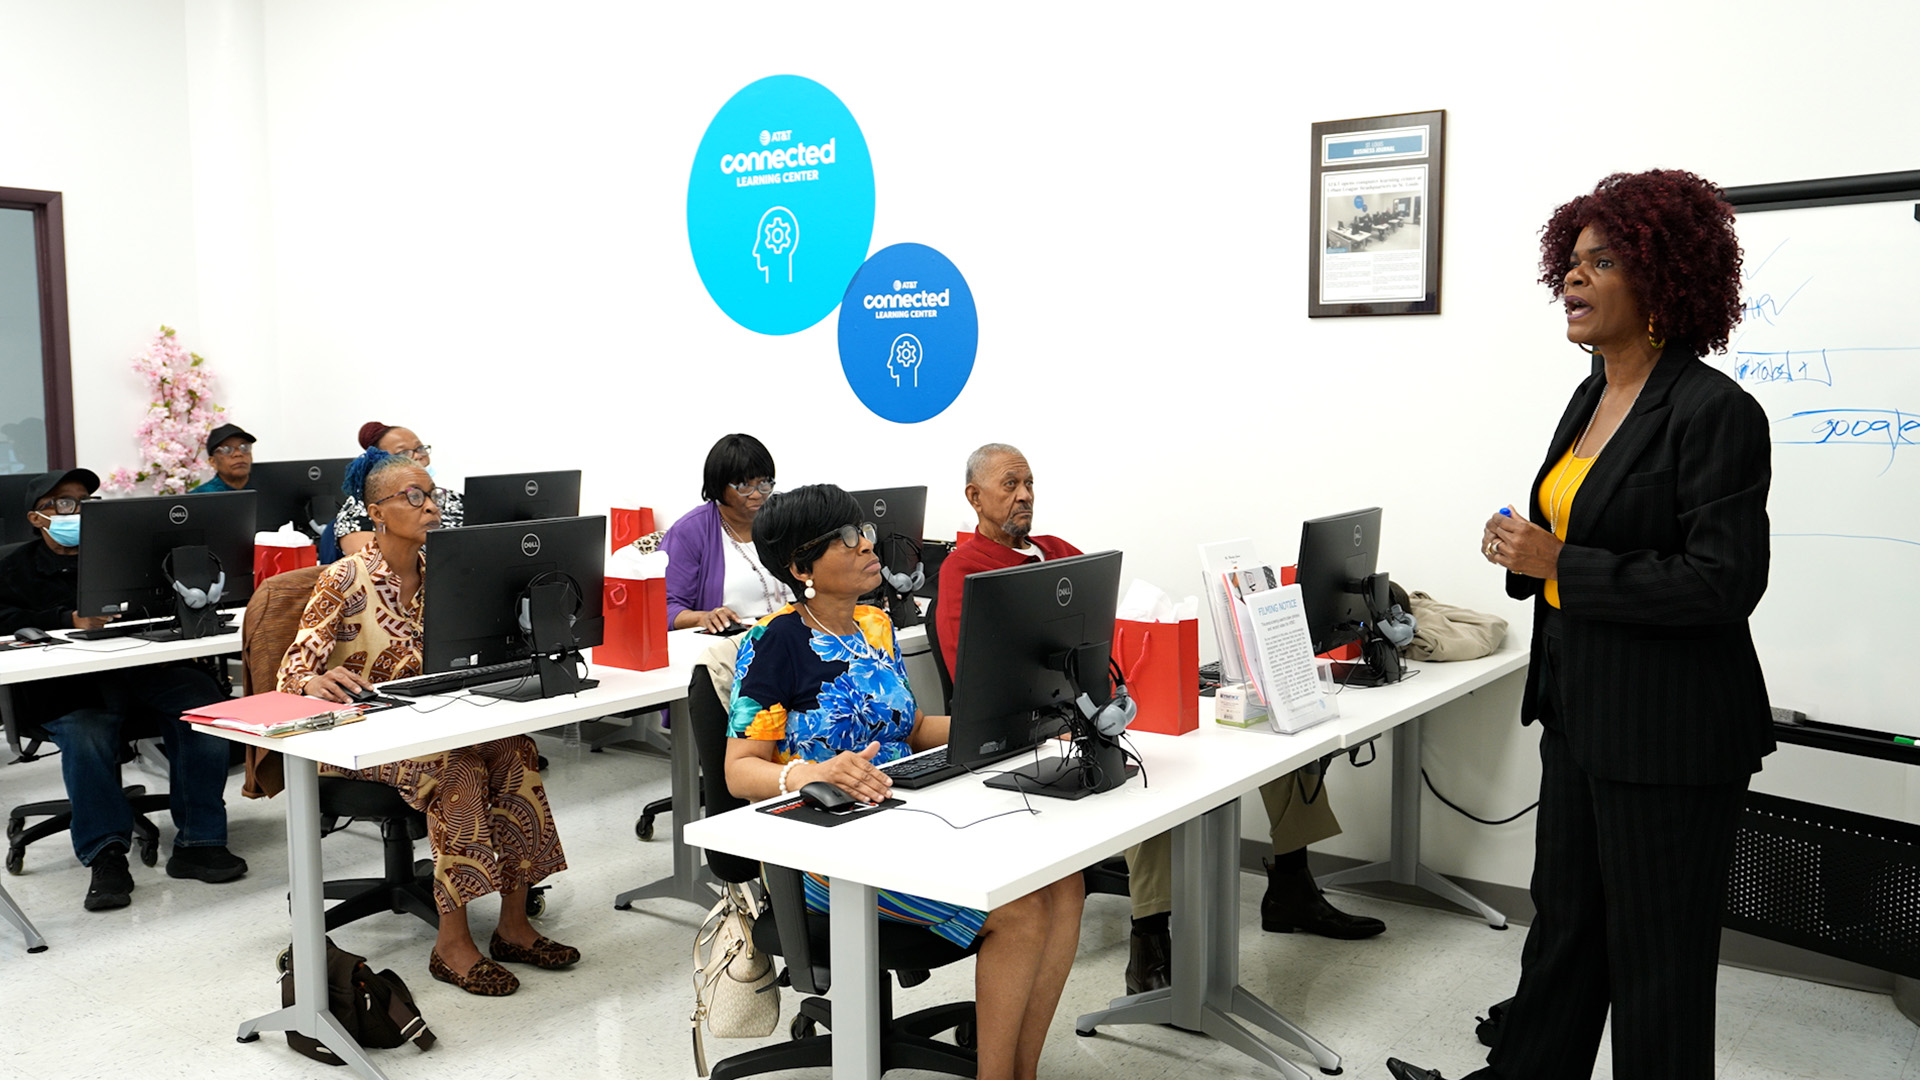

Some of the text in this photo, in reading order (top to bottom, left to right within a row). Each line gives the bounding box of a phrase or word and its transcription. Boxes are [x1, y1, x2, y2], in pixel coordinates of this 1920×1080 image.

[771, 130, 792, 142] AT&T
[720, 137, 836, 175] connected
[736, 170, 819, 187] LEARNING CENTER
[902, 280, 918, 289] AT&T
[863, 288, 950, 310] connected
[875, 310, 937, 319] LEARNING CENTER
[524, 541, 538, 549] DELL
[1059, 588, 1071, 597] DELL
[1258, 598, 1298, 616] FILMING NOTICE
